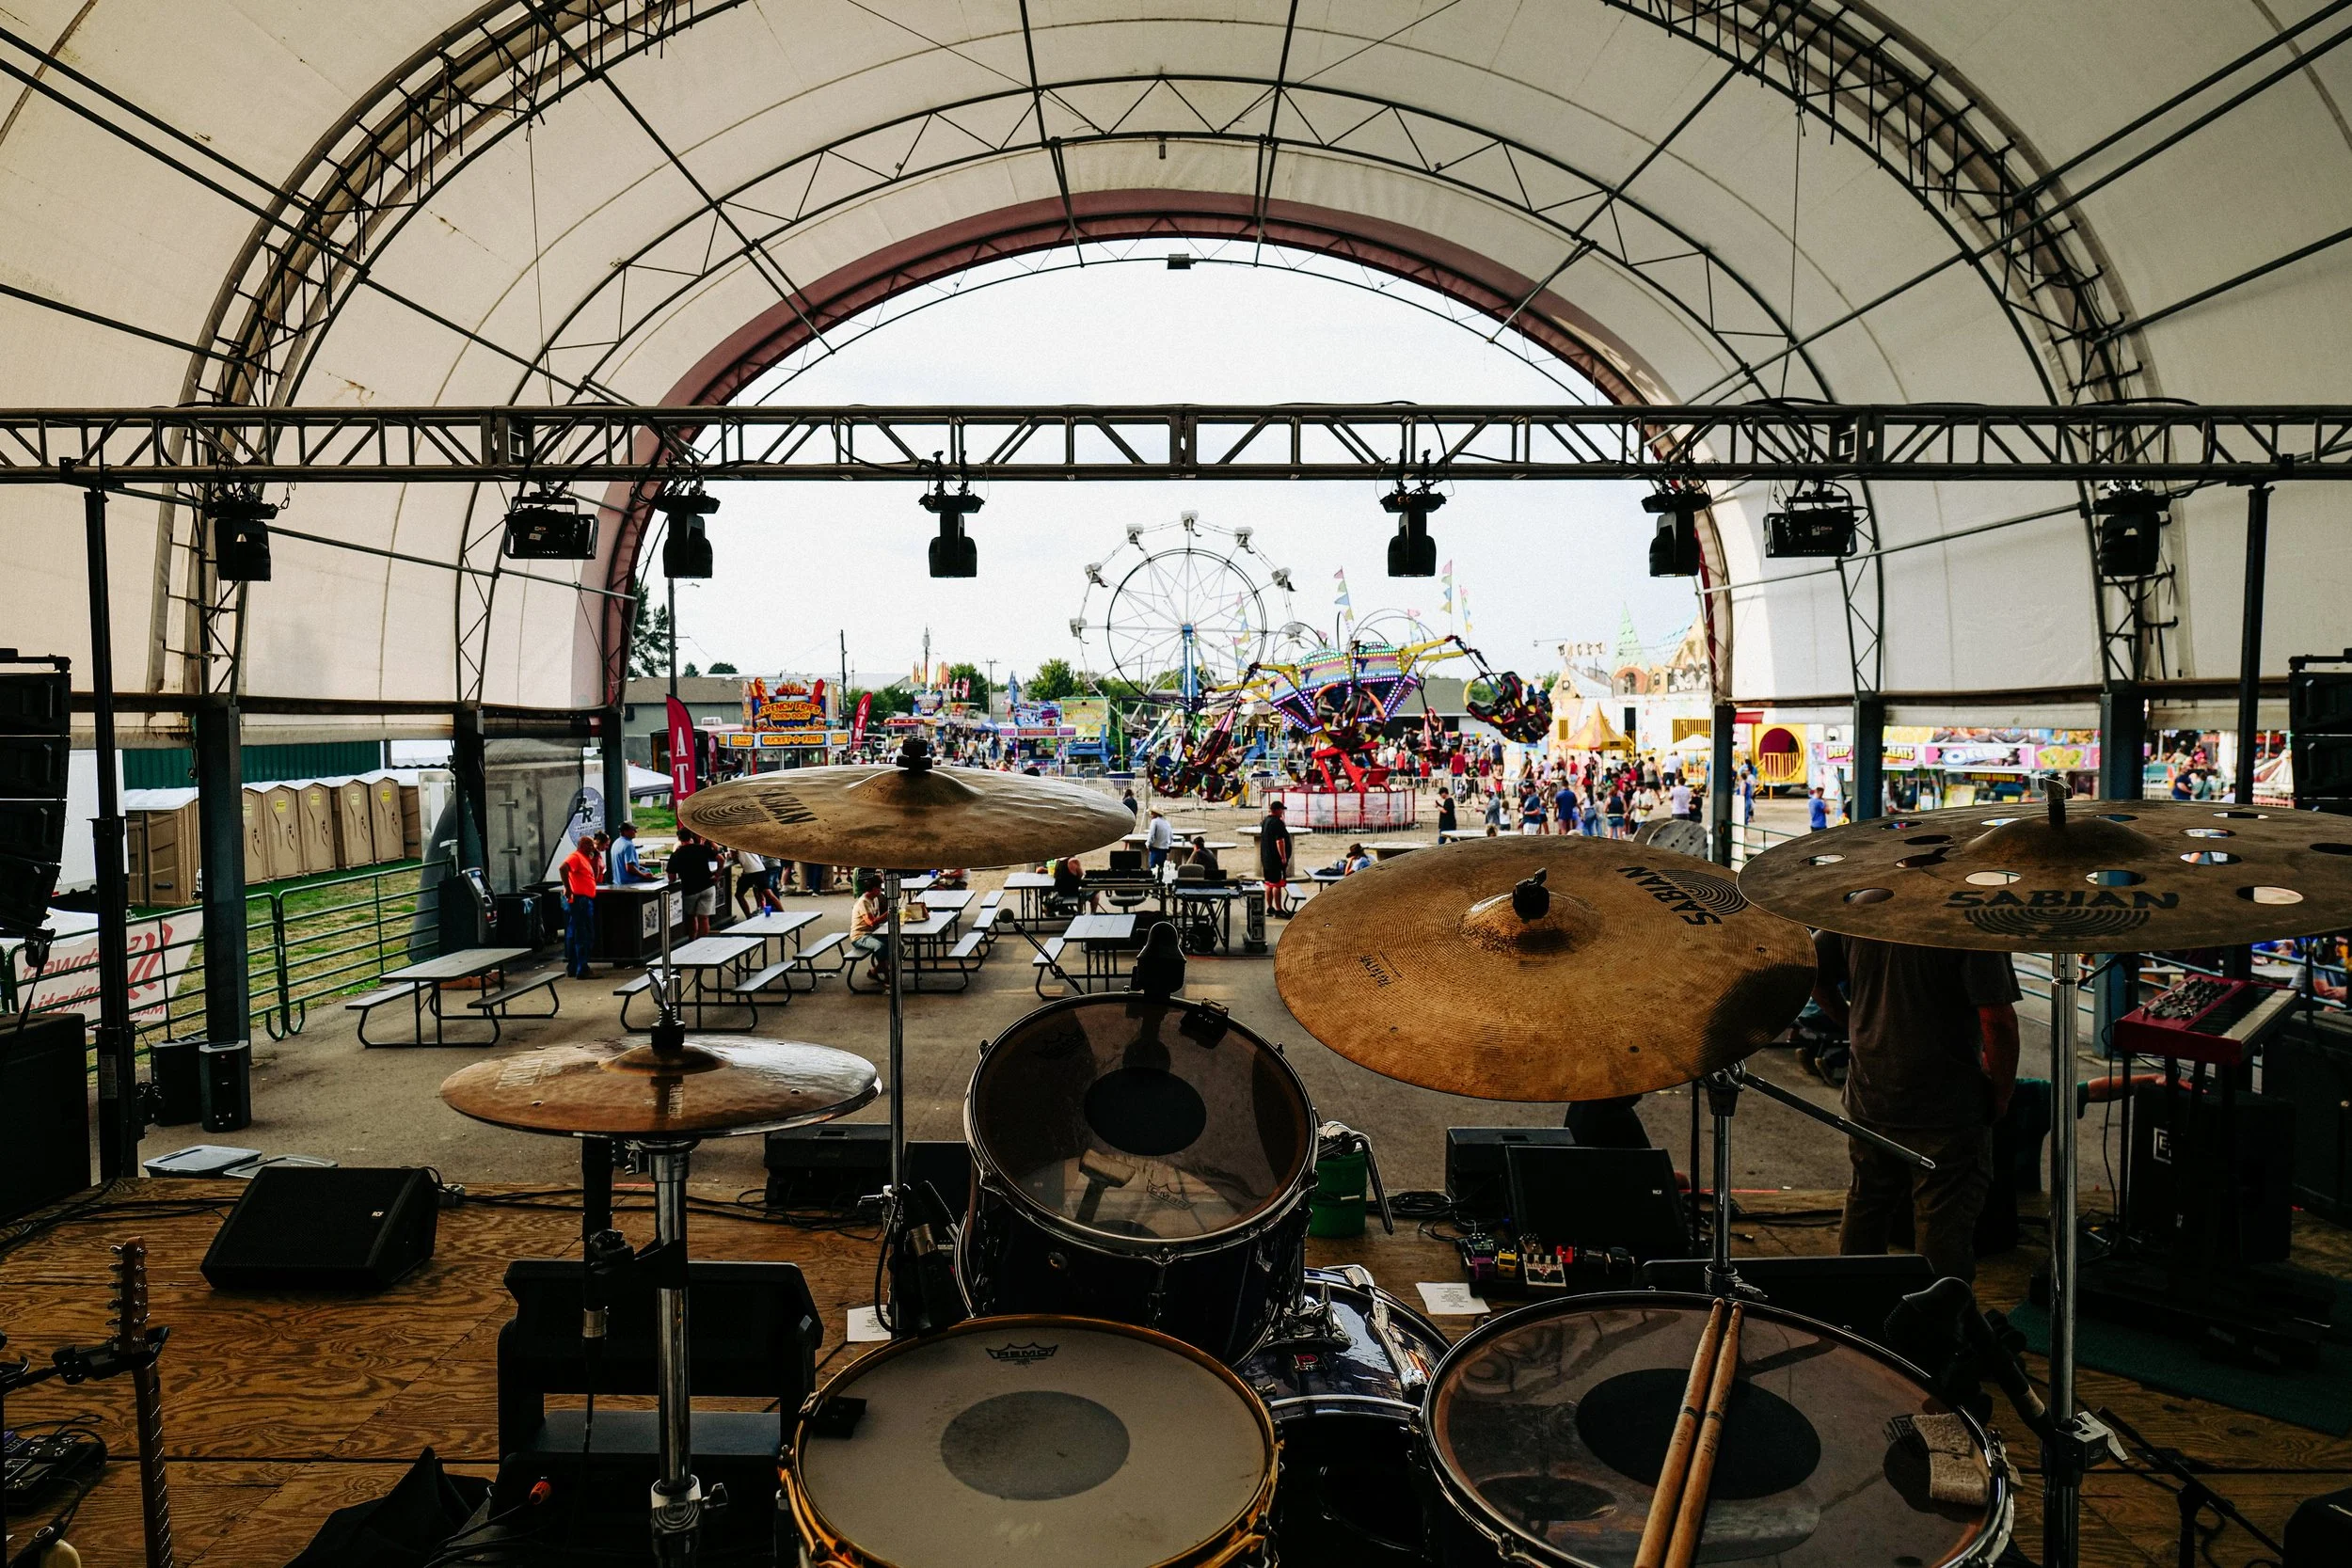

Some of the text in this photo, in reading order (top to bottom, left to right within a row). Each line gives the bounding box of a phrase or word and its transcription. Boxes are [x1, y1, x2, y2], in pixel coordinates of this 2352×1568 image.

[759, 701, 821, 715] FRENCH FRIES
[763, 736, 823, 745] BUCKET-O-FRIES
[1827, 745, 1851, 759] DEEP
[1615, 866, 1724, 926] SABIAN
[1942, 889, 2180, 910] SABIAN
[997, 1349, 1049, 1358] REMO
